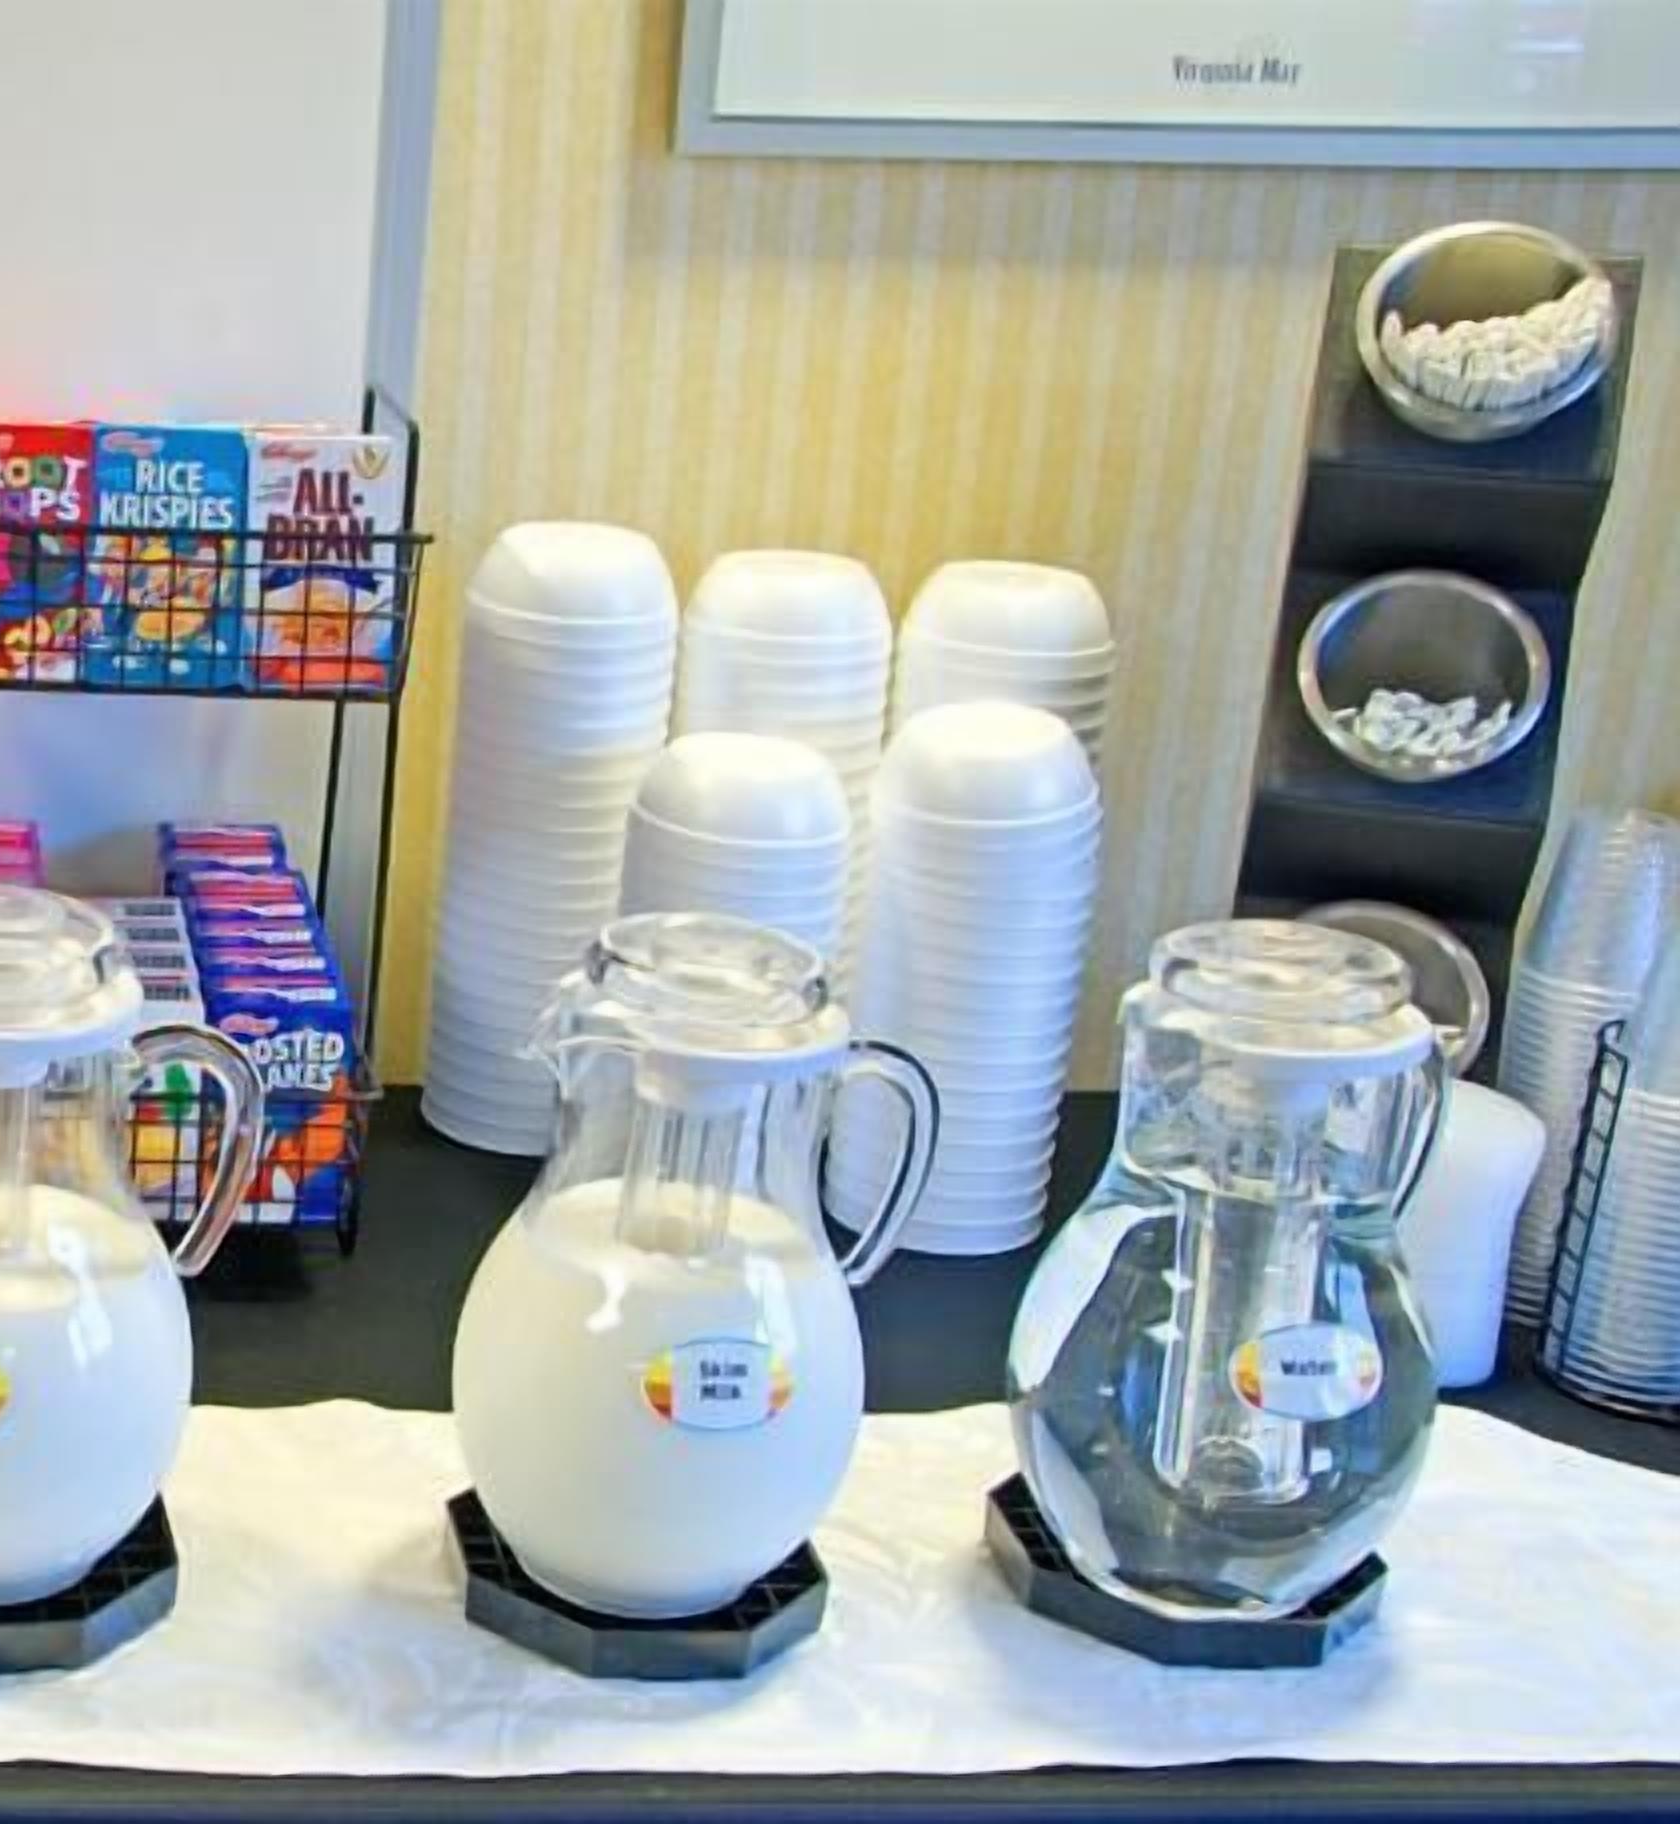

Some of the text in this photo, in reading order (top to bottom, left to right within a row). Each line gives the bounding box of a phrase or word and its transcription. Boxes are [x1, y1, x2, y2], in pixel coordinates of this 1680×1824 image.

[135, 459, 204, 494] RICE
[293, 467, 364, 514] ALL-
[99, 490, 234, 530] KRISPIES
[263, 512, 375, 562] BRAN
[1281, 1359, 1339, 1376] Water
